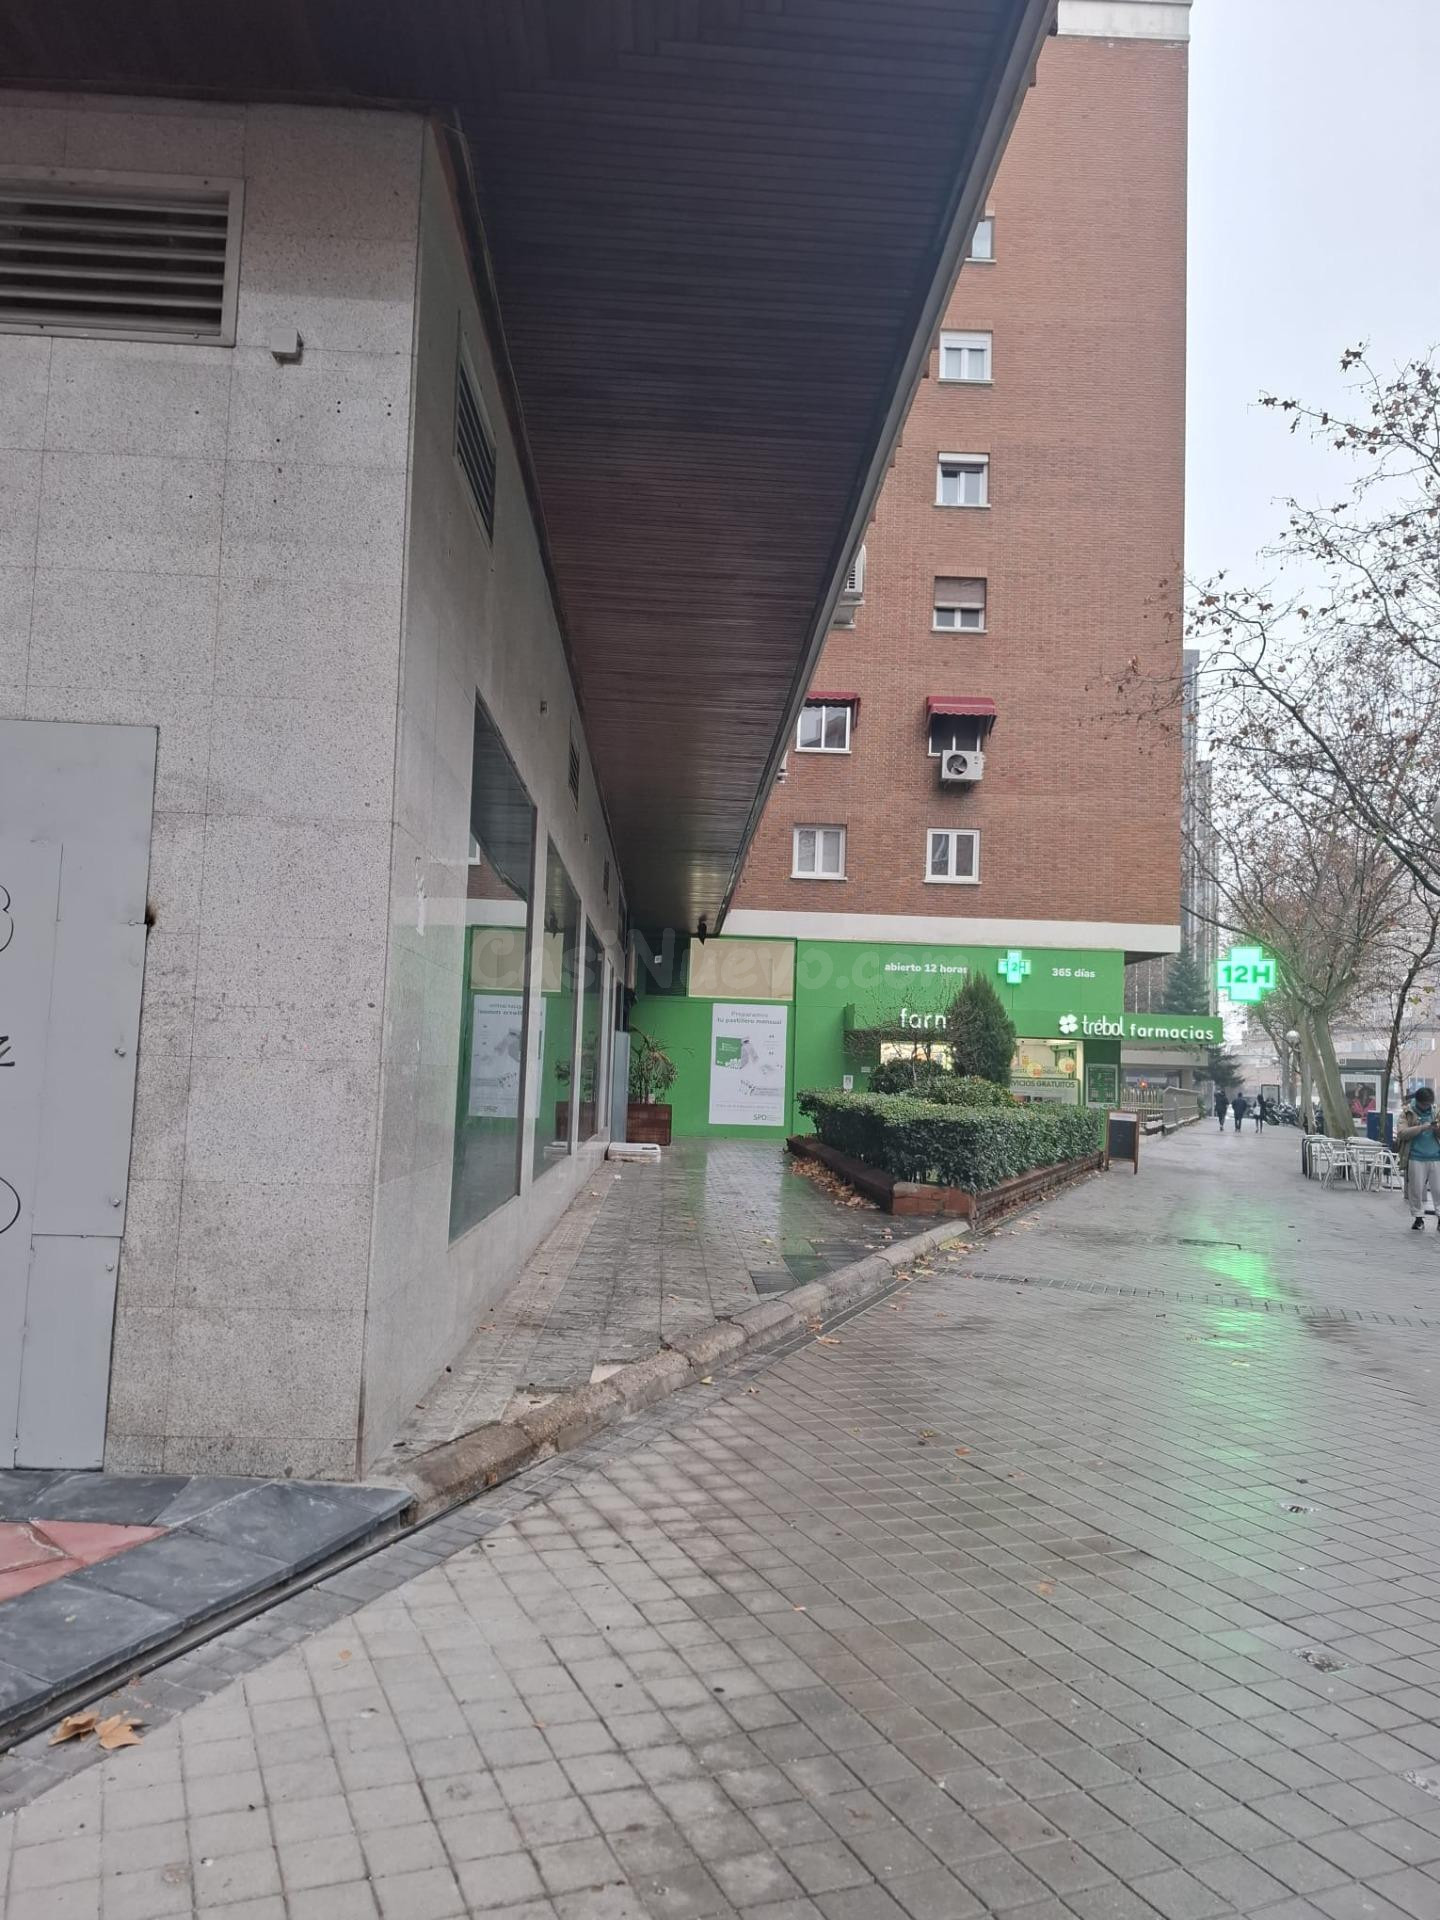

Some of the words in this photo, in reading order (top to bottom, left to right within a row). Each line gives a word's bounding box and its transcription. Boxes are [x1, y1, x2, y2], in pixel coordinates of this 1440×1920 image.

[884, 962, 921, 972] abierto
[924, 963, 937, 972] 12
[939, 964, 968, 974] horas
[1052, 968, 1071, 977] 365
[1074, 968, 1095, 978] días
[1223, 965, 1270, 983] 12H
[1081, 1015, 1125, 1036] trébol
[1130, 1023, 1214, 1040] farmacias
